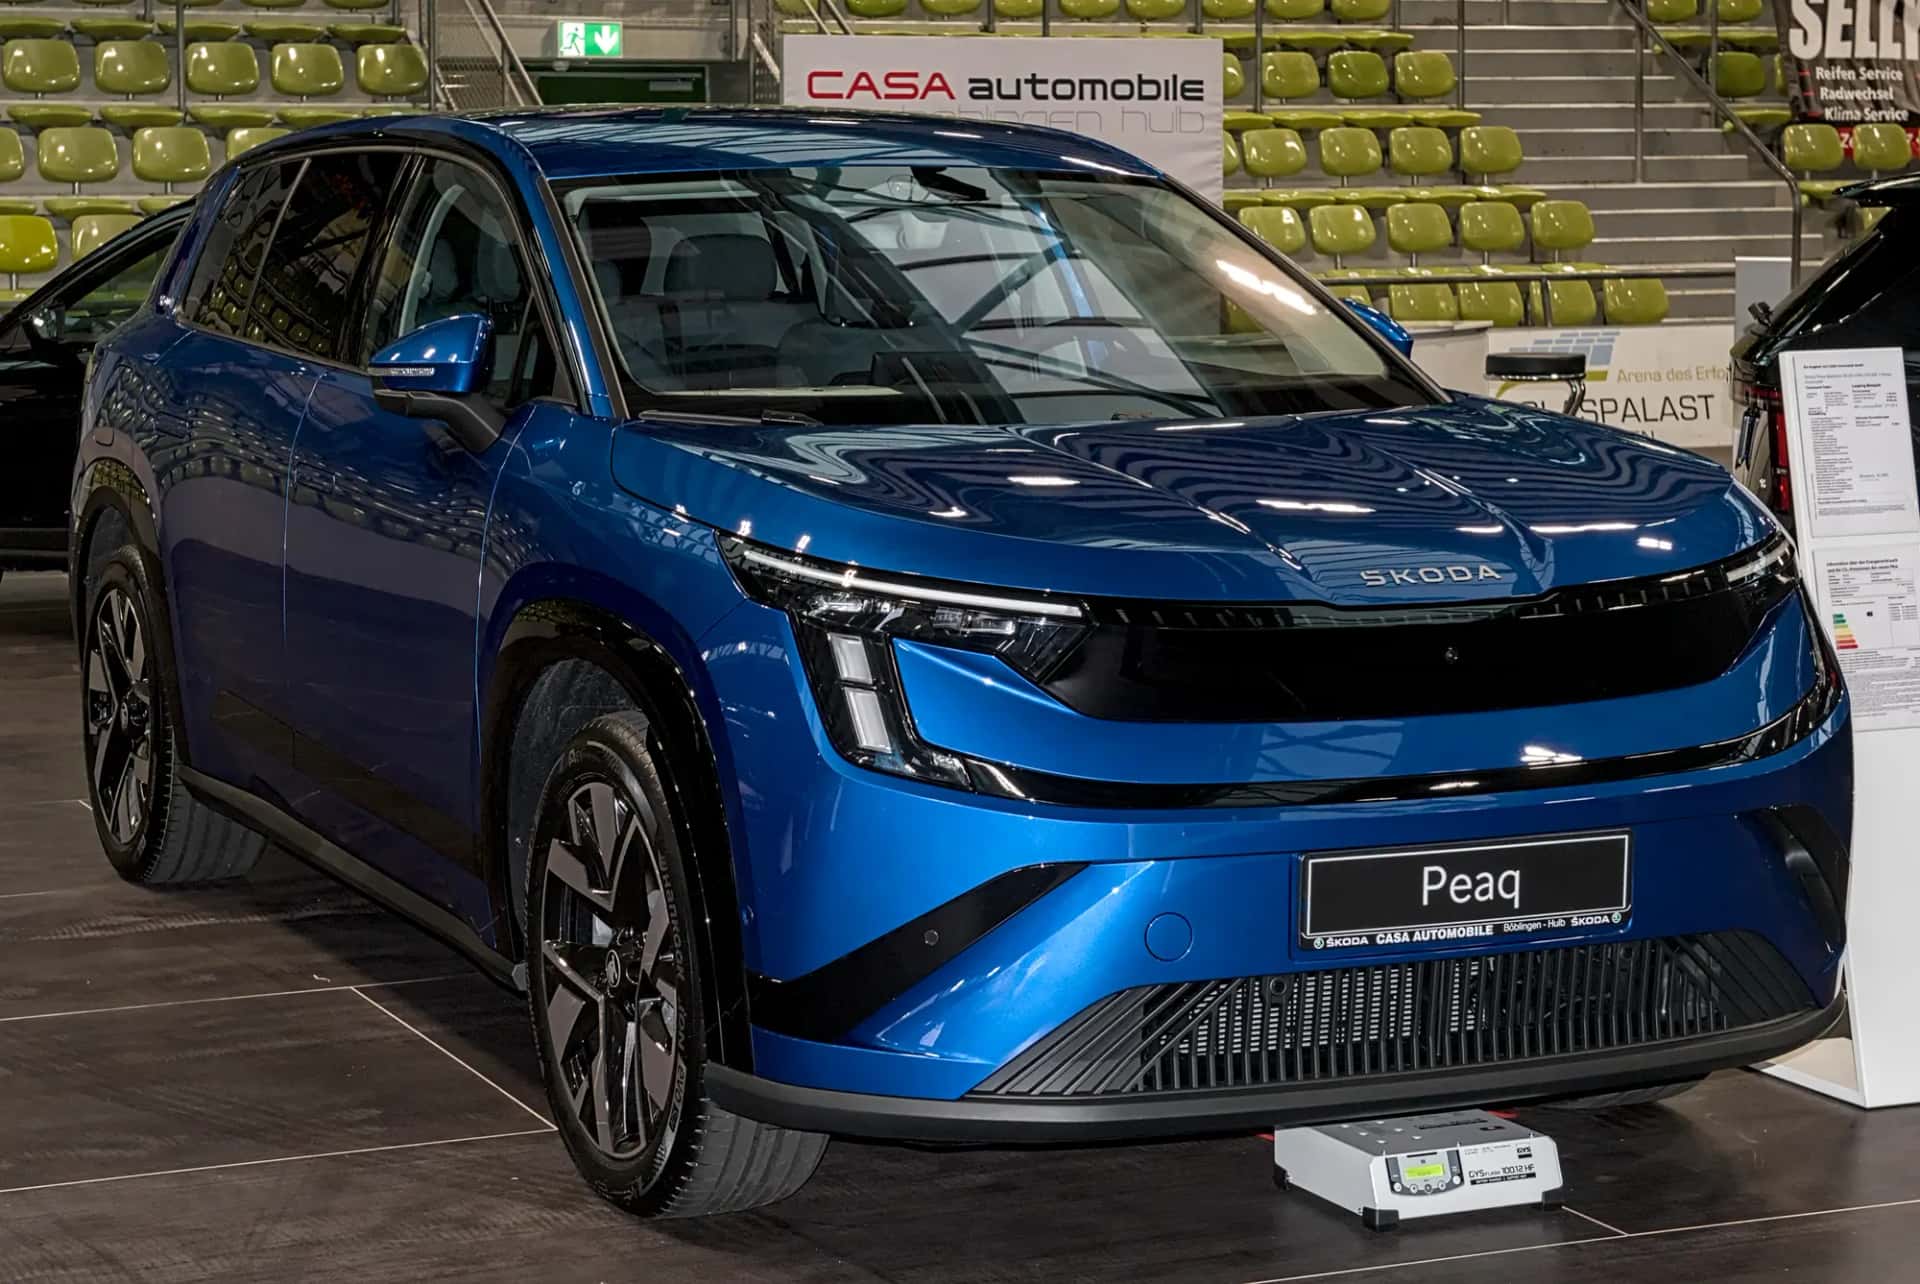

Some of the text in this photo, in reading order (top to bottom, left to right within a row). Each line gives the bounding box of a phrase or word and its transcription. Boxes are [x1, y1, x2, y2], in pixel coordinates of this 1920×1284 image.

[1815, 65, 1904, 81] Reifen Service
[808, 71, 1204, 101] CASA automobile
[1820, 86, 1894, 100] Radwechsel
[1825, 106, 1909, 122] Klima Service
[1617, 365, 1730, 383] Arena des Erfo
[1422, 865, 1520, 909] Peaq
[1326, 935, 1369, 948] ŠKODA
[1376, 931, 1410, 944] CASA
[1412, 925, 1493, 942] AUTOMOBILE
[1503, 920, 1542, 933] Böblingen
[1570, 915, 1610, 927] ŠKODA
